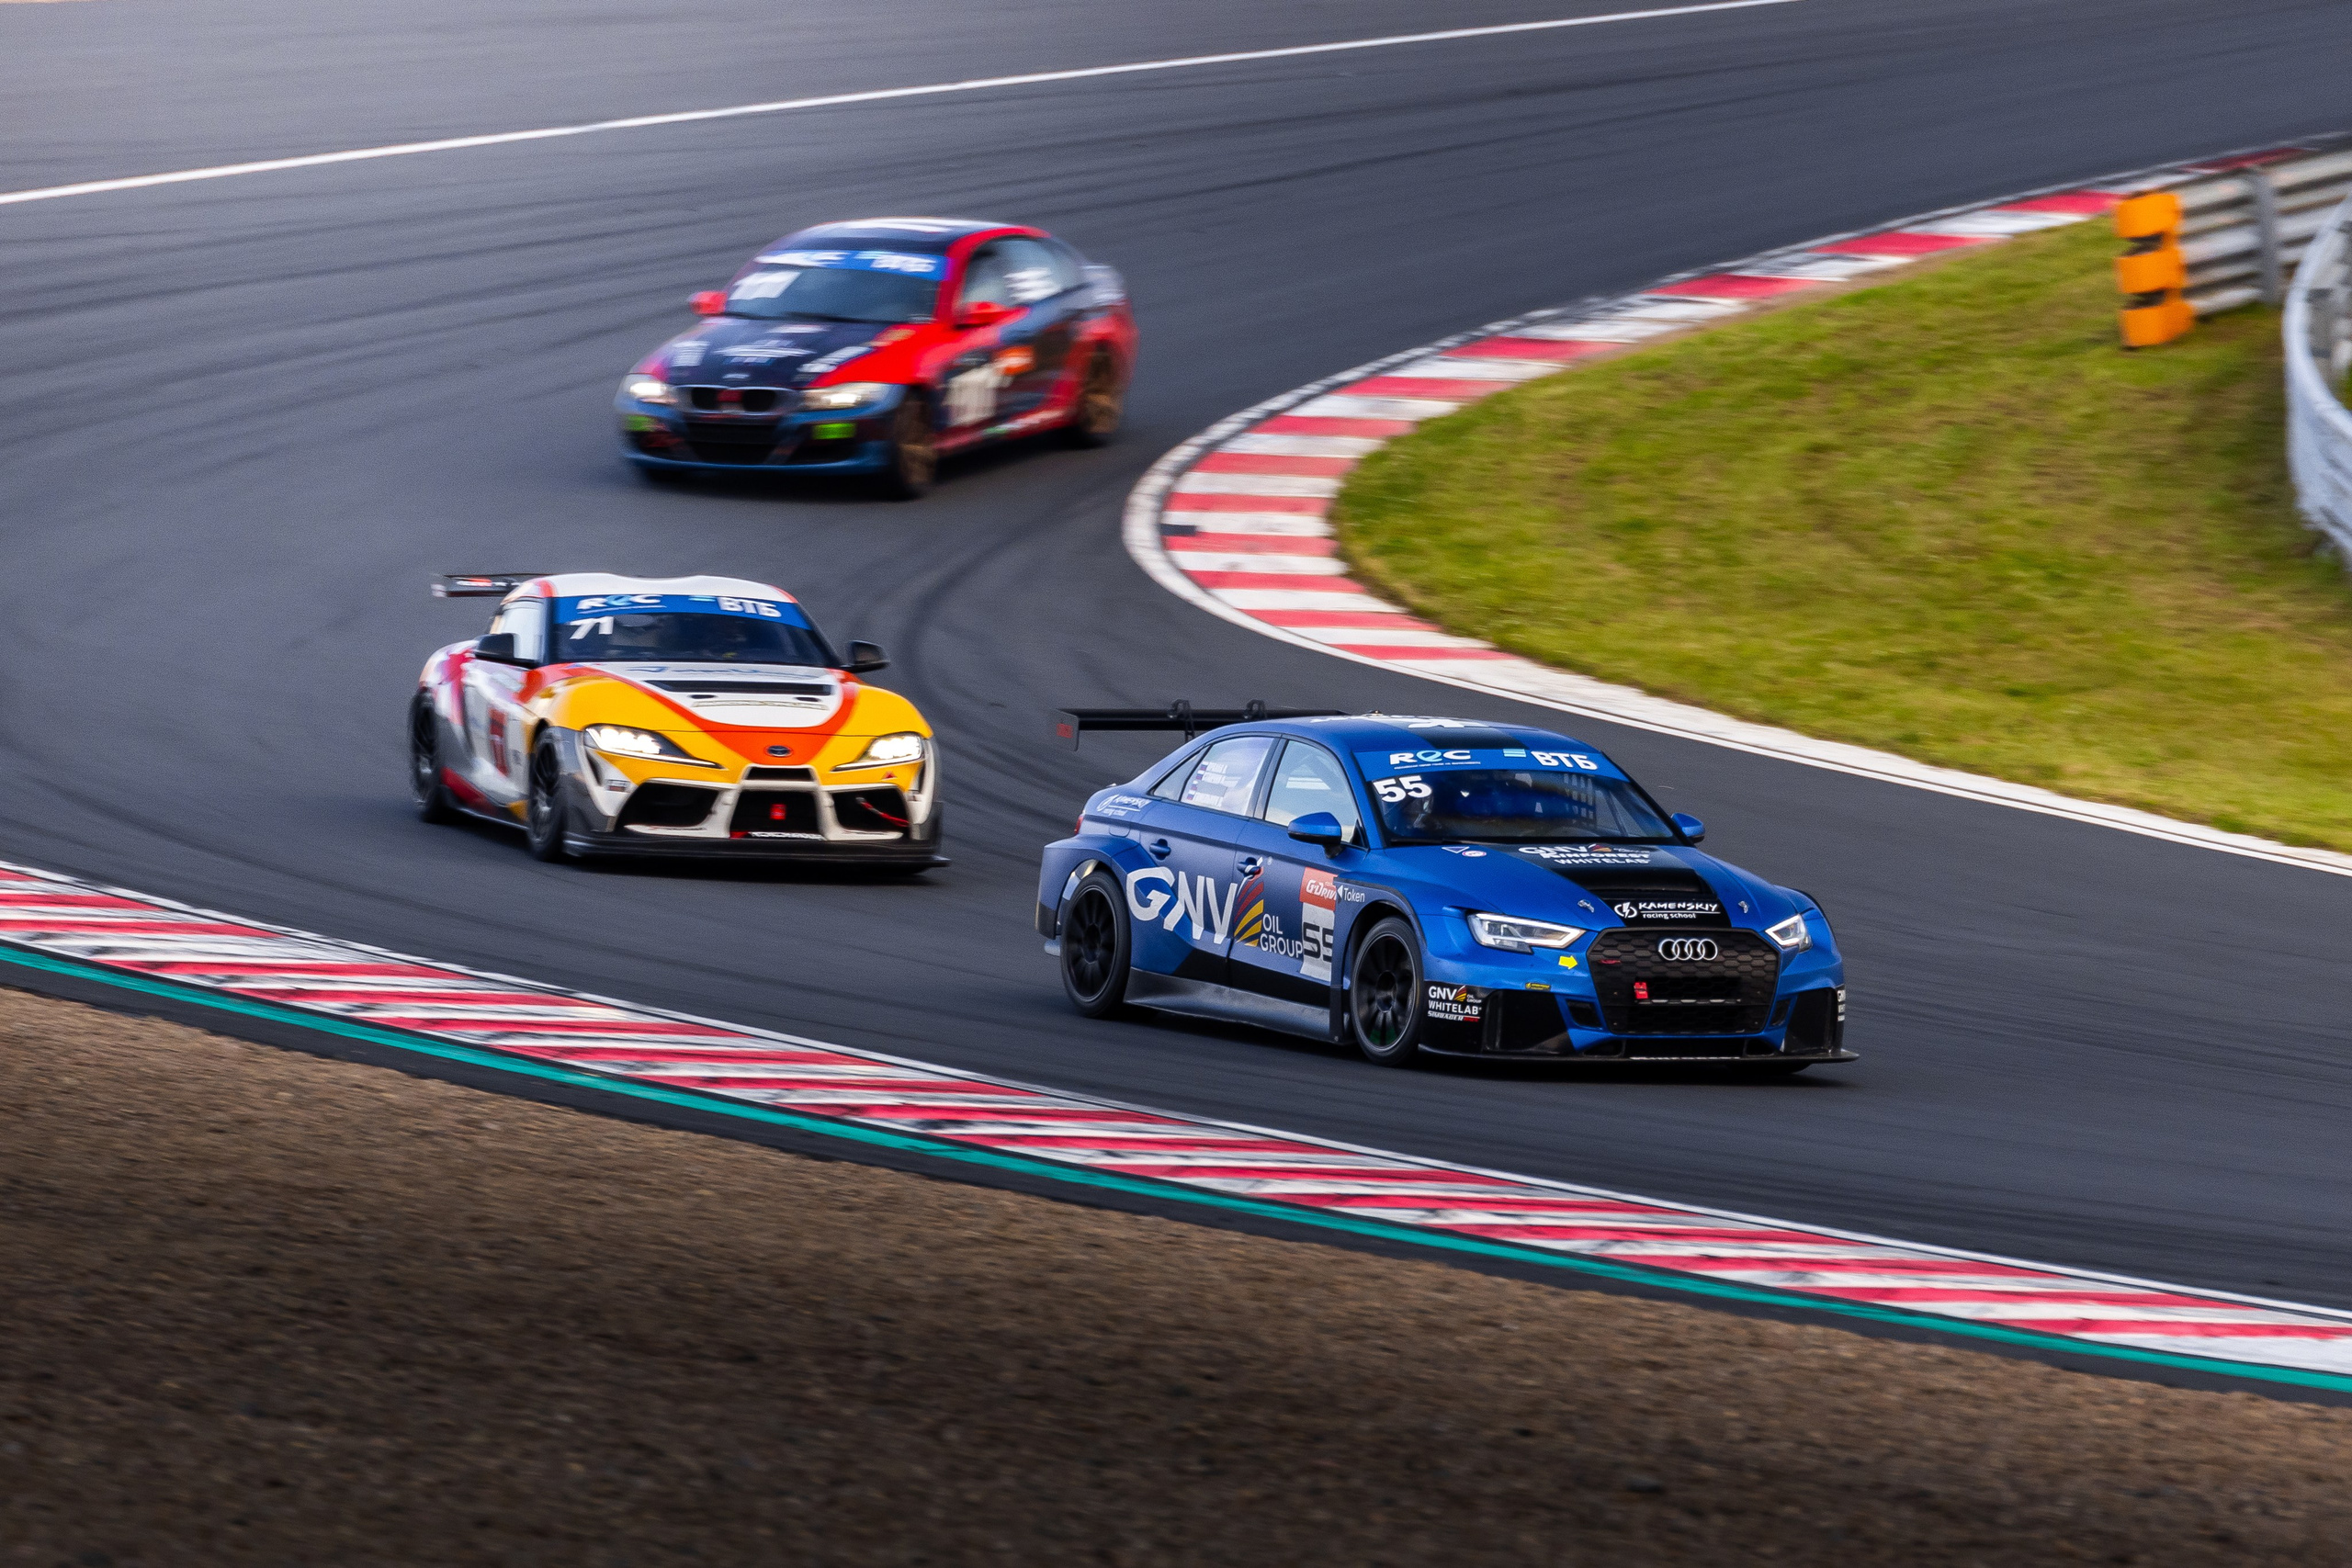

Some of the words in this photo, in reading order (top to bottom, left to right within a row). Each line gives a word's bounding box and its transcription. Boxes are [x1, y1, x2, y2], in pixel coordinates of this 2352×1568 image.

[717, 597, 782, 618] ВТБ
[570, 615, 614, 640] 71
[1531, 750, 1599, 771] ВТБ
[1373, 774, 1433, 803] 55
[1518, 846, 1589, 855] GNV
[1125, 866, 1238, 945] GNV
[1343, 887, 1365, 903] Token
[1638, 902, 1718, 912] KAMENSKIY
[1262, 913, 1283, 935] OIL
[1260, 933, 1303, 958] GROUP
[1428, 986, 1457, 1000] GNV
[1429, 1000, 1479, 1015] WHITELAB
